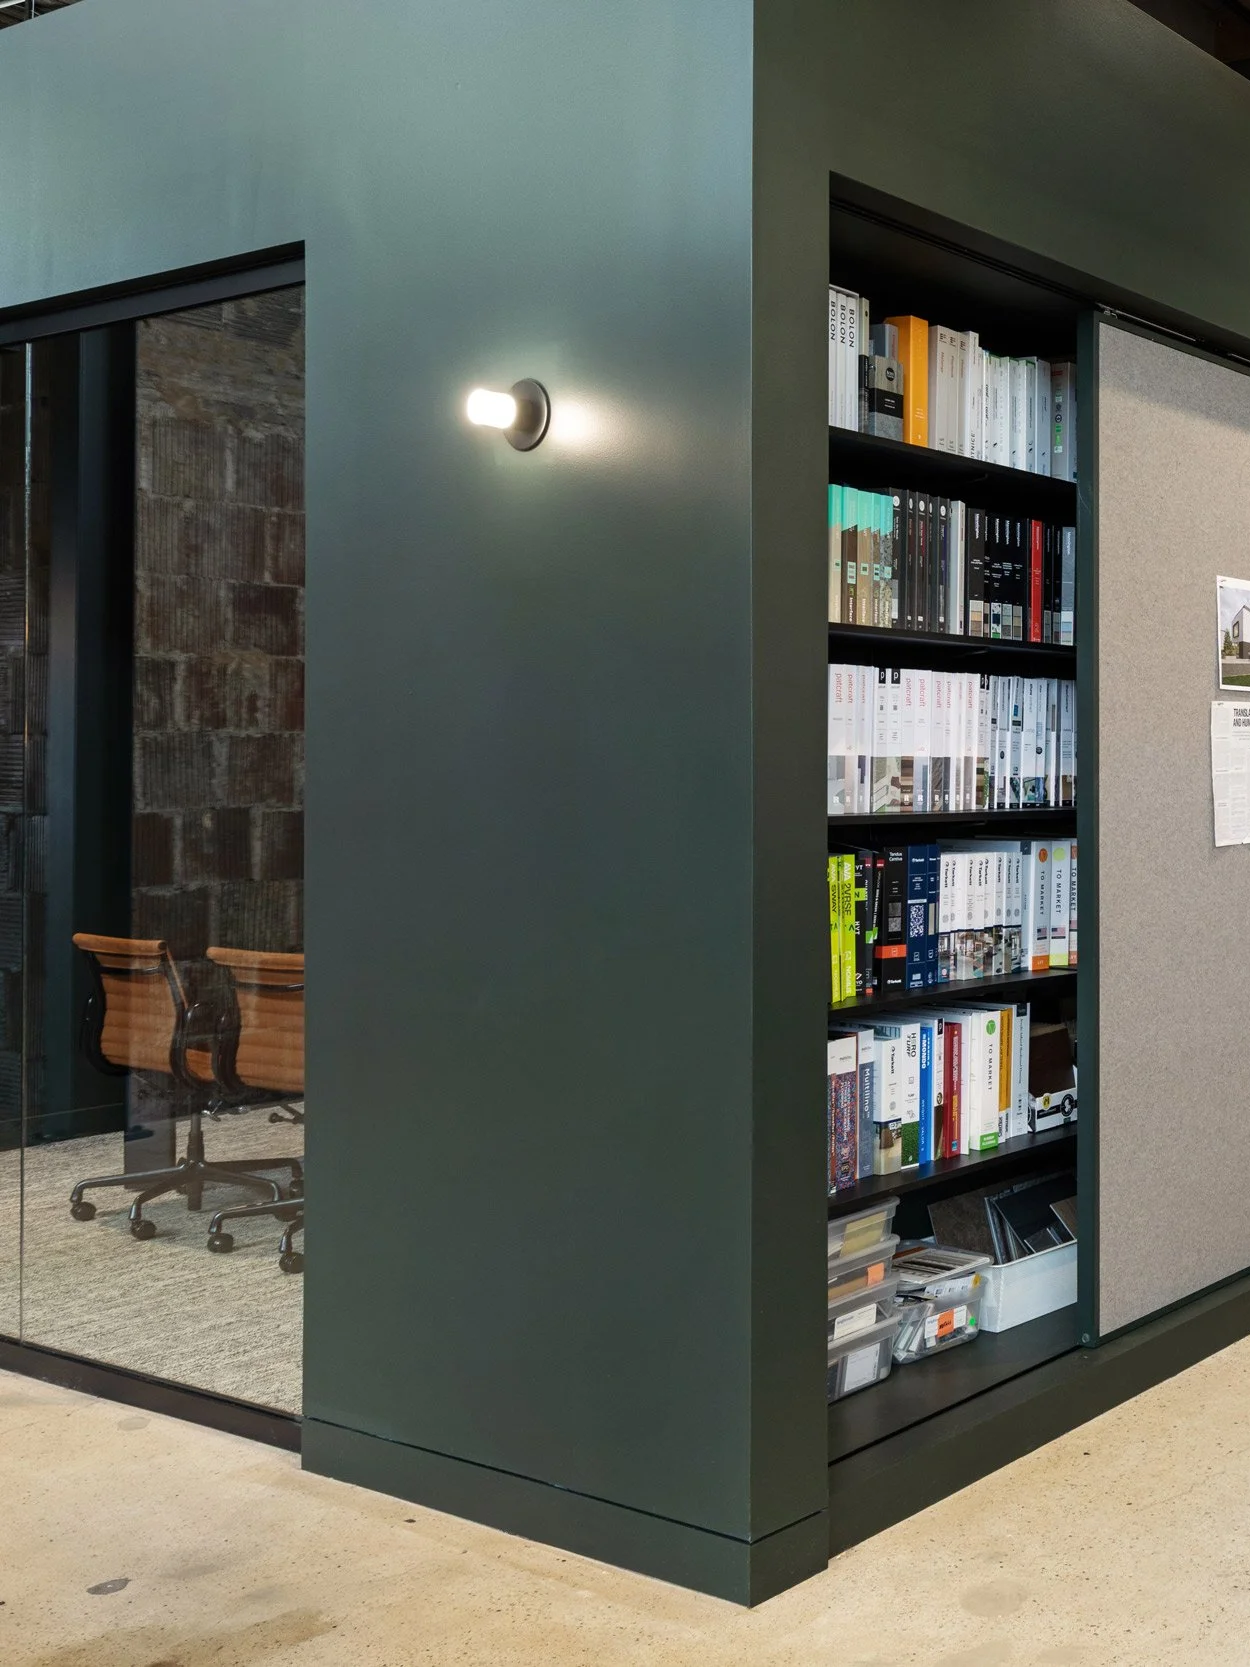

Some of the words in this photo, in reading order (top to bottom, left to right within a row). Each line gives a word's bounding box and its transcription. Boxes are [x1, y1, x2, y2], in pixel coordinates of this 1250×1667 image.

[1233, 718, 1241, 727] AND
[1040, 871, 1045, 880] TO
[1056, 870, 1062, 879] TO
[1071, 868, 1076, 877] TO
[988, 1044, 992, 1054] TO
